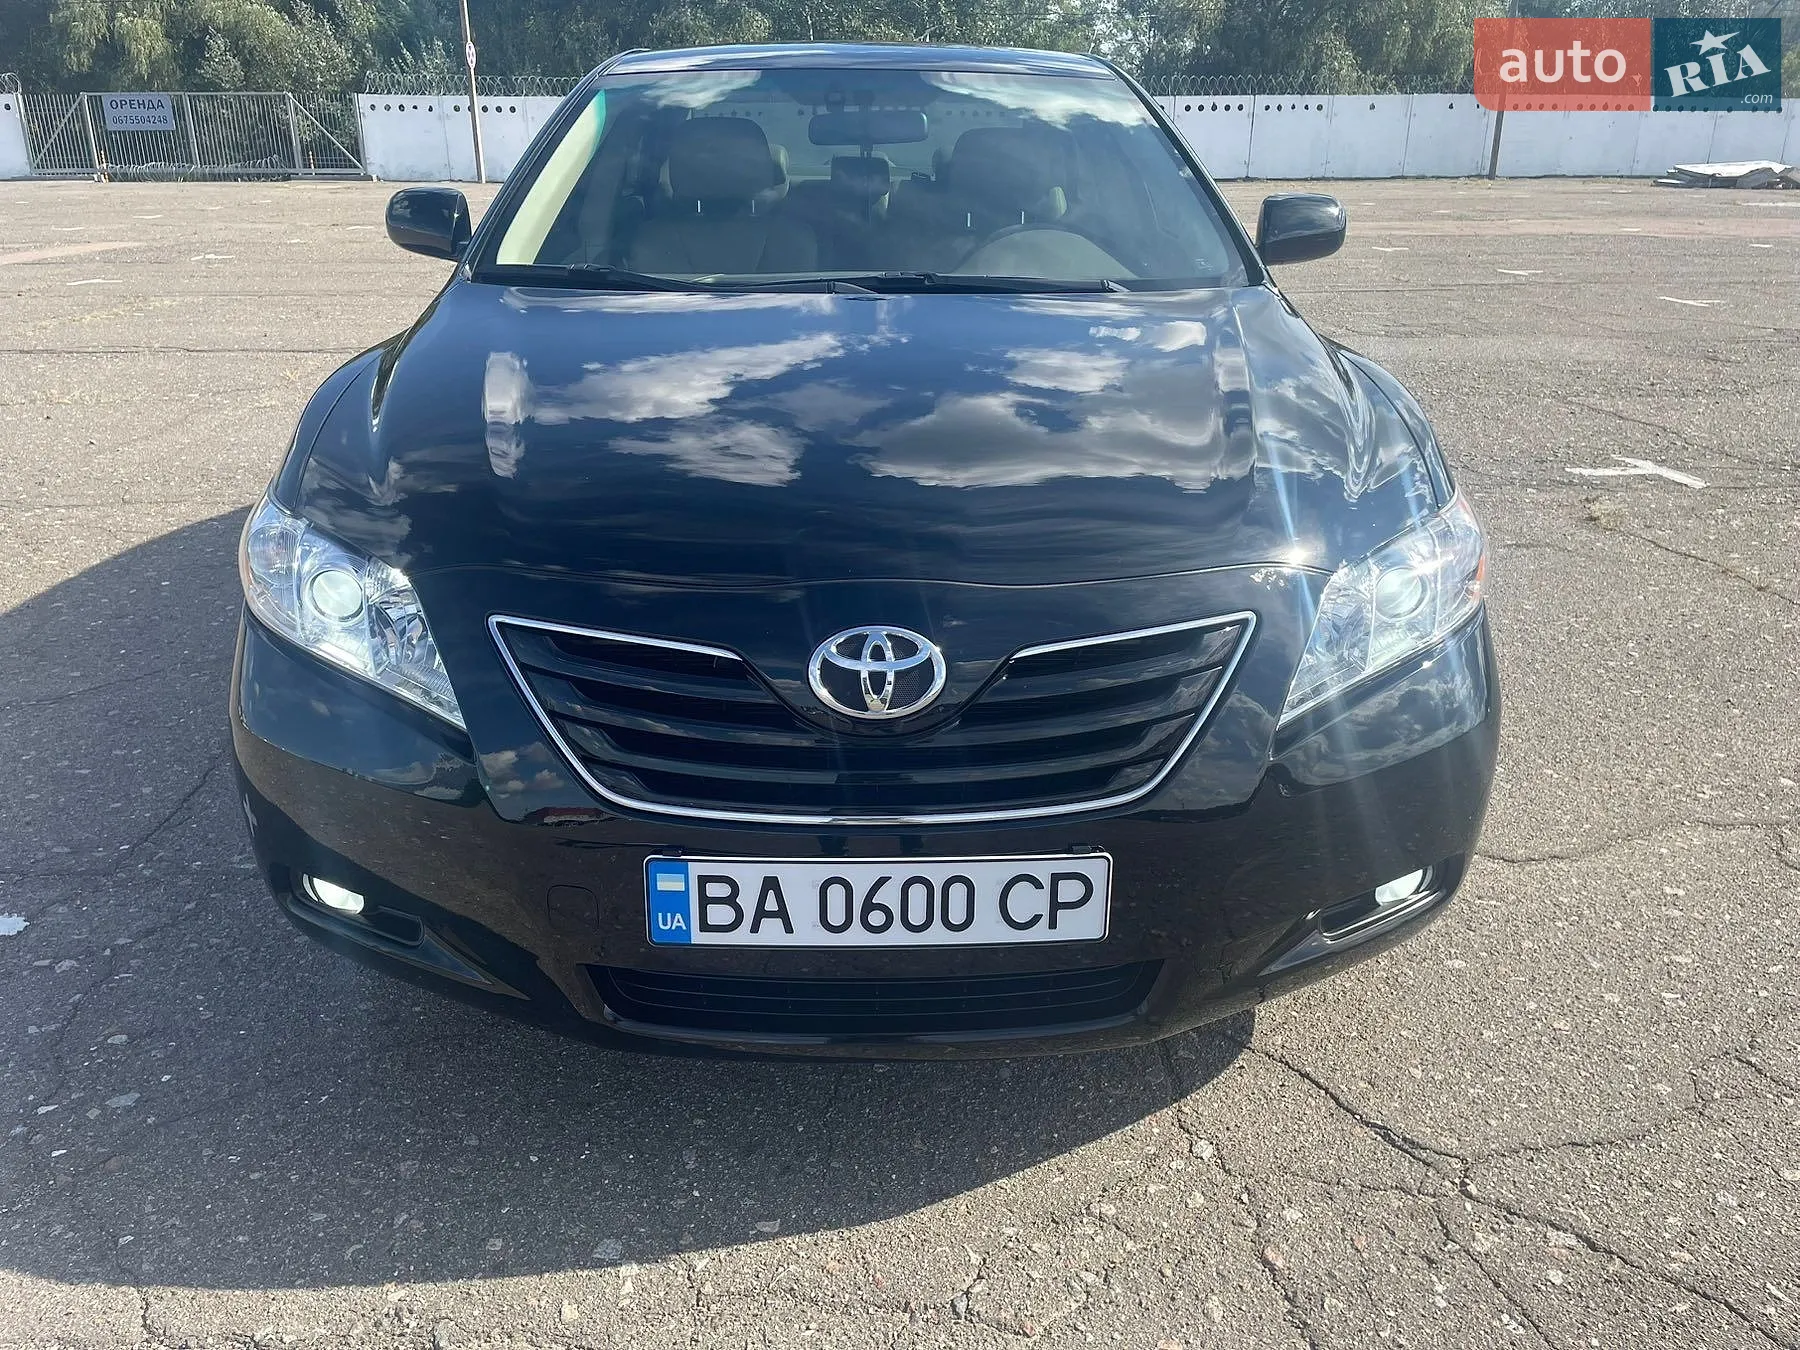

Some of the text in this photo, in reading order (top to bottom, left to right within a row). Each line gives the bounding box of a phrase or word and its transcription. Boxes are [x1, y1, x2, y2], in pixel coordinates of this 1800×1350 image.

[109, 98, 165, 111] ОРЕНДА
[112, 115, 168, 125] 0675504248
[696, 871, 1094, 934] BA 0600 CP
[657, 912, 687, 931] UA
